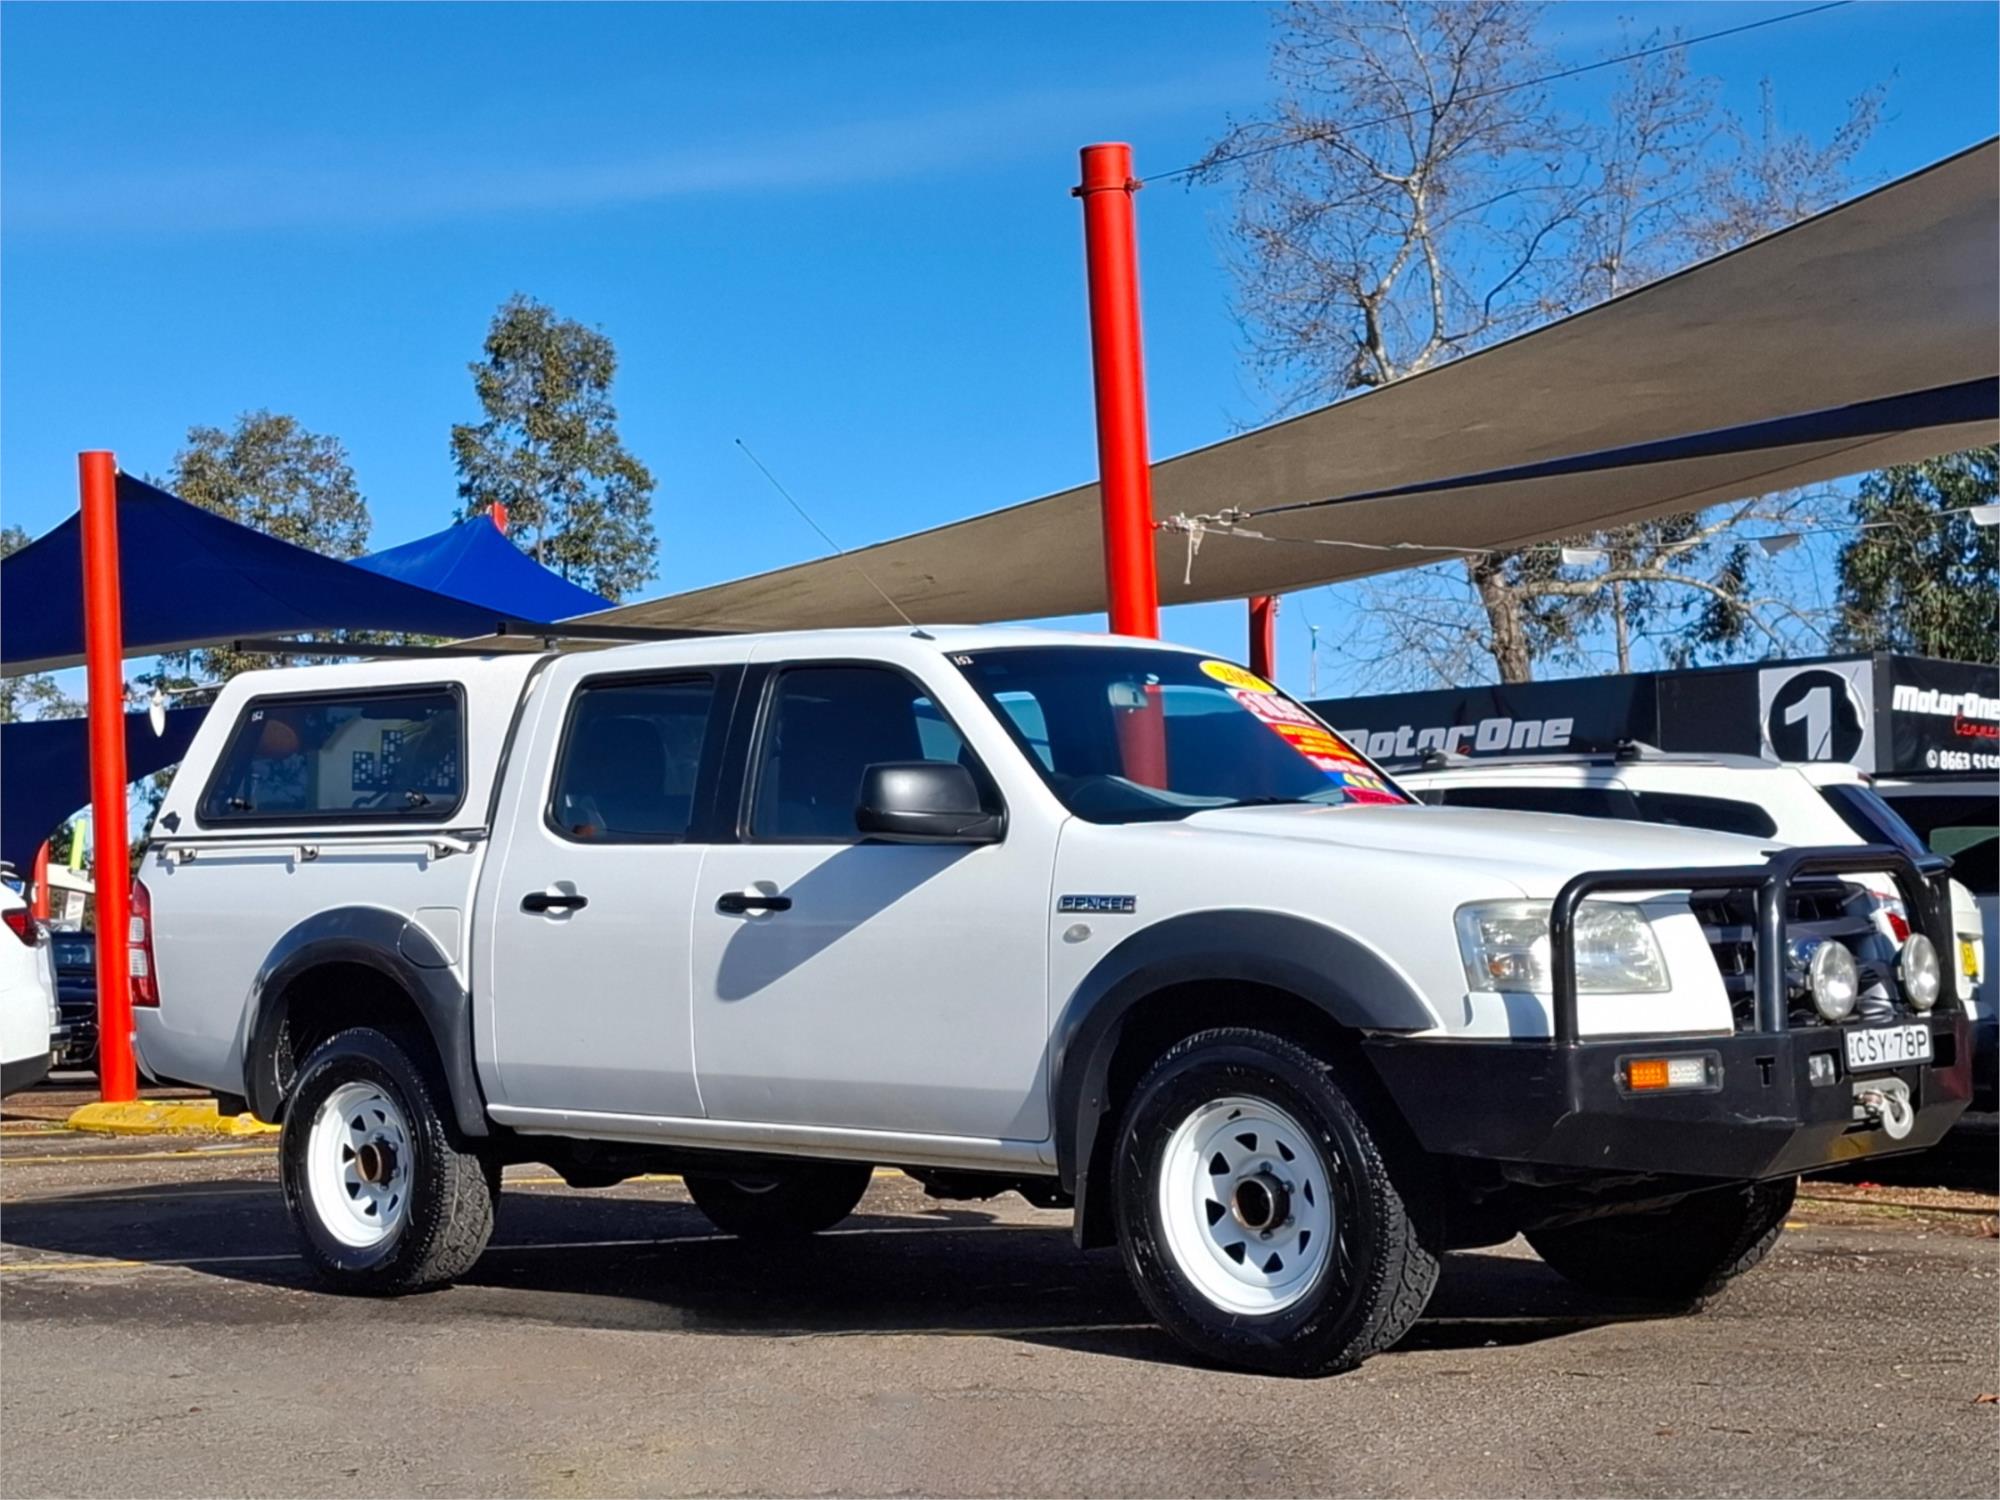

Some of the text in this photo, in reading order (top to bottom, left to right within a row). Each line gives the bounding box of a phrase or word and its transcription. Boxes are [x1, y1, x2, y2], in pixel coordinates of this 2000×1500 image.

[1892, 684, 2000, 721] MotorOne
[1784, 686, 1832, 760] 1
[1940, 750, 1971, 770] 8663
[1058, 895, 1135, 912] RANGER
